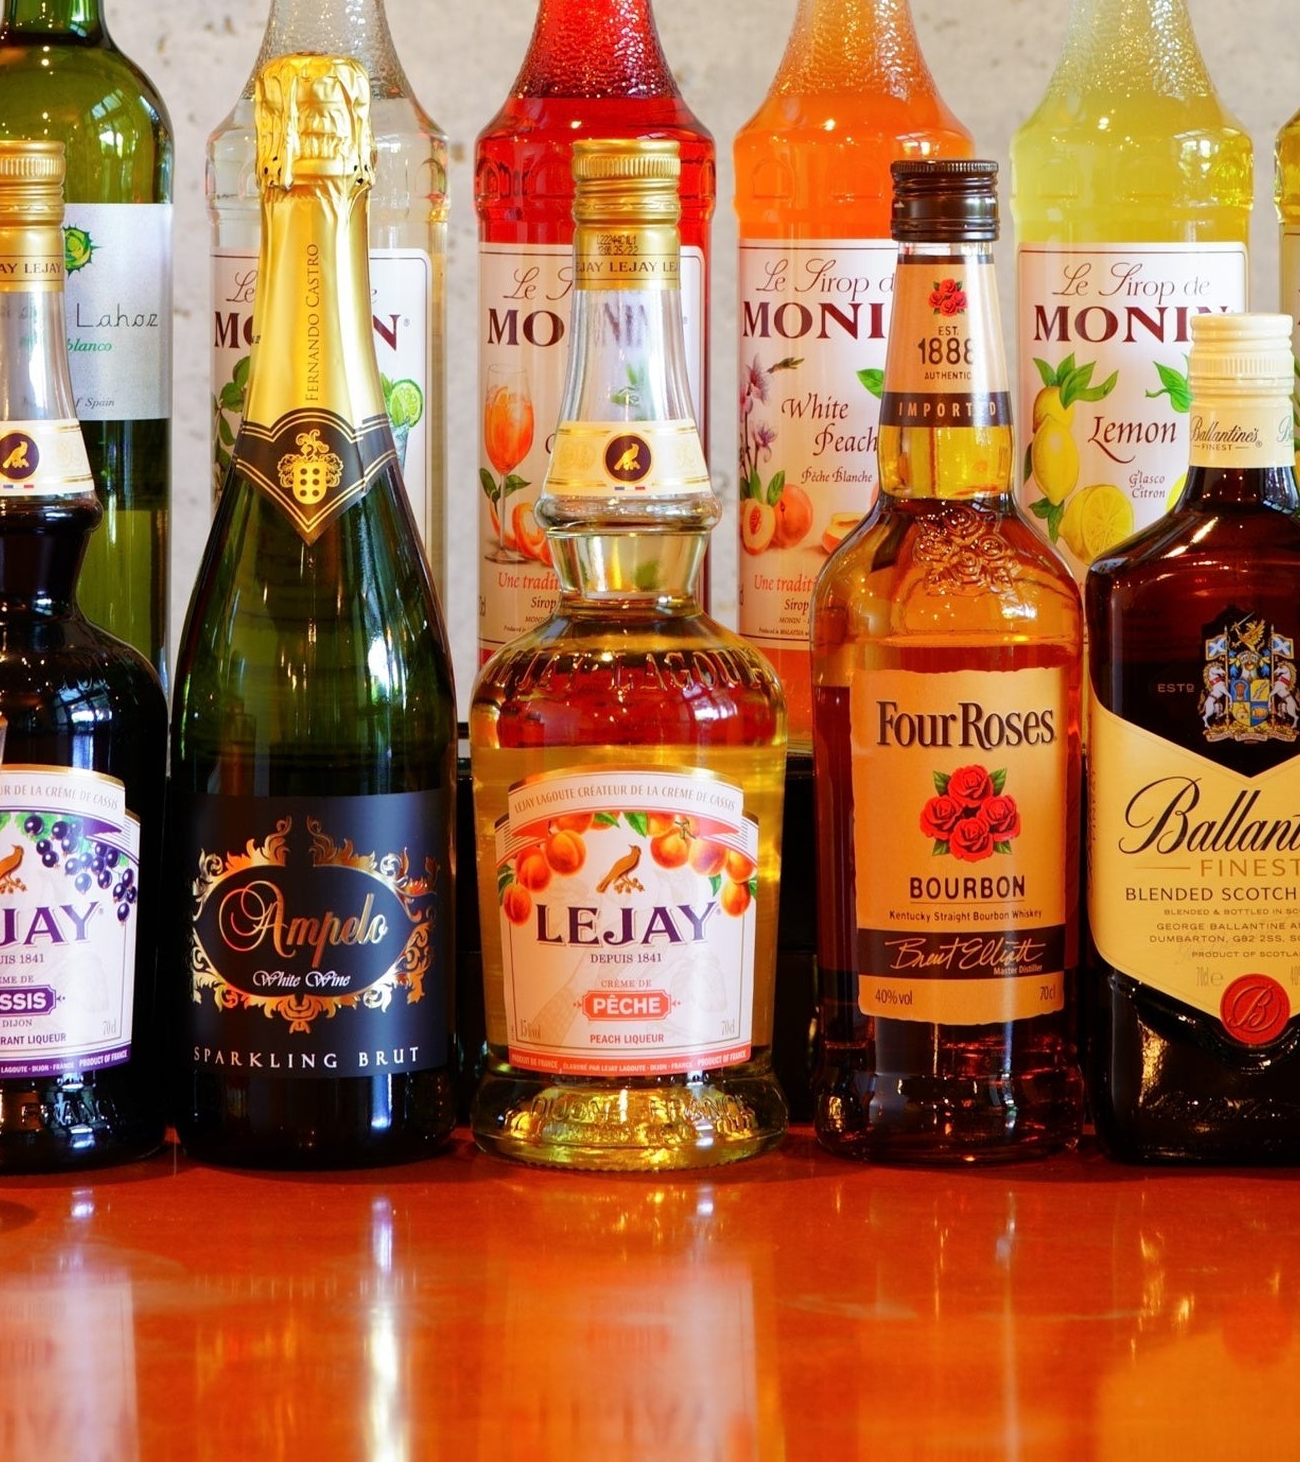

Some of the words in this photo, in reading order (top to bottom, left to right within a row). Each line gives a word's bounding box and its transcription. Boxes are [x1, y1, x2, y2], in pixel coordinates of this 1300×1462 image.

[24, 263, 62, 274] LEJAY
[305, 242, 319, 309] CASTRO
[609, 261, 660, 273] LEJAY
[756, 258, 786, 293] Le
[794, 258, 870, 303] Sirop
[1052, 262, 1092, 296] Le
[1098, 262, 1175, 305] Sirop
[1184, 276, 1210, 296] de
[743, 301, 889, 340] MONI
[305, 312, 319, 402] FERNANDO
[924, 370, 973, 381] AUTHENTIC
[84, 397, 115, 410] Spain
[781, 393, 849, 421] White
[898, 401, 998, 418] IMPORTD
[814, 423, 878, 458] Peach
[1088, 416, 1177, 464] Lemon
[1201, 443, 1233, 451] FINEST
[498, 571, 520, 588] Une
[754, 574, 775, 590] Une
[530, 594, 557, 613] Sirop
[784, 597, 809, 616] Sirop
[876, 700, 957, 747] Four
[958, 701, 1056, 751] Roses
[14, 785, 26, 795] DE
[30, 785, 42, 796] LA
[514, 796, 535, 814] LEJAY
[536, 788, 574, 805] LAGOUTE
[578, 784, 627, 799] CRÉATEUR
[630, 785, 644, 796] DE
[647, 785, 658, 796] LA
[709, 795, 736, 812] CASSIS
[909, 874, 1025, 900] BOURBON
[1125, 887, 1214, 902] BLENDED
[1221, 886, 1298, 901] SCOTCH
[889, 910, 931, 923] Kentucky
[934, 911, 971, 924] Straight
[973, 910, 1010, 921] Bourbon
[1011, 909, 1043, 919] Whiskey
[1163, 908, 1210, 916] BLENDED
[1223, 908, 1269, 916] BOTTLED
[1272, 908, 1283, 916] IN
[219, 880, 388, 968] Ampelo
[535, 902, 719, 947] LEJAY
[1156, 922, 1205, 932] GEORGE
[1209, 921, 1286, 931] BALLANTINE
[20, 954, 45, 965] 1841
[589, 952, 635, 965] DEPUIS
[637, 952, 662, 964] 1841
[1191, 951, 1238, 959] PRODUCT
[993, 965, 1018, 976] Master
[1018, 964, 1043, 974] Distiller
[20, 975, 34, 984] DE
[252, 970, 301, 988] White
[305, 970, 351, 988] Wine
[638, 978, 653, 989] DE
[592, 991, 662, 1016] PÊCHE
[2, 1019, 33, 1028] DIJON
[27, 1033, 67, 1045] LIQUEUR
[589, 1033, 621, 1045] PEACH
[624, 1033, 664, 1045] LIQUEUR
[0, 1066, 28, 1074] LAGOUTE
[79, 1057, 104, 1068] PRODUCT
[104, 1055, 111, 1064] OF
[193, 1046, 338, 1069] SPARKLING
[358, 1046, 420, 1068] BRUT
[601, 1063, 618, 1073] LEJAY
[619, 1063, 646, 1073] LAGOUTE
[697, 1056, 722, 1067] PRODUCT
[722, 1054, 729, 1064] OF
